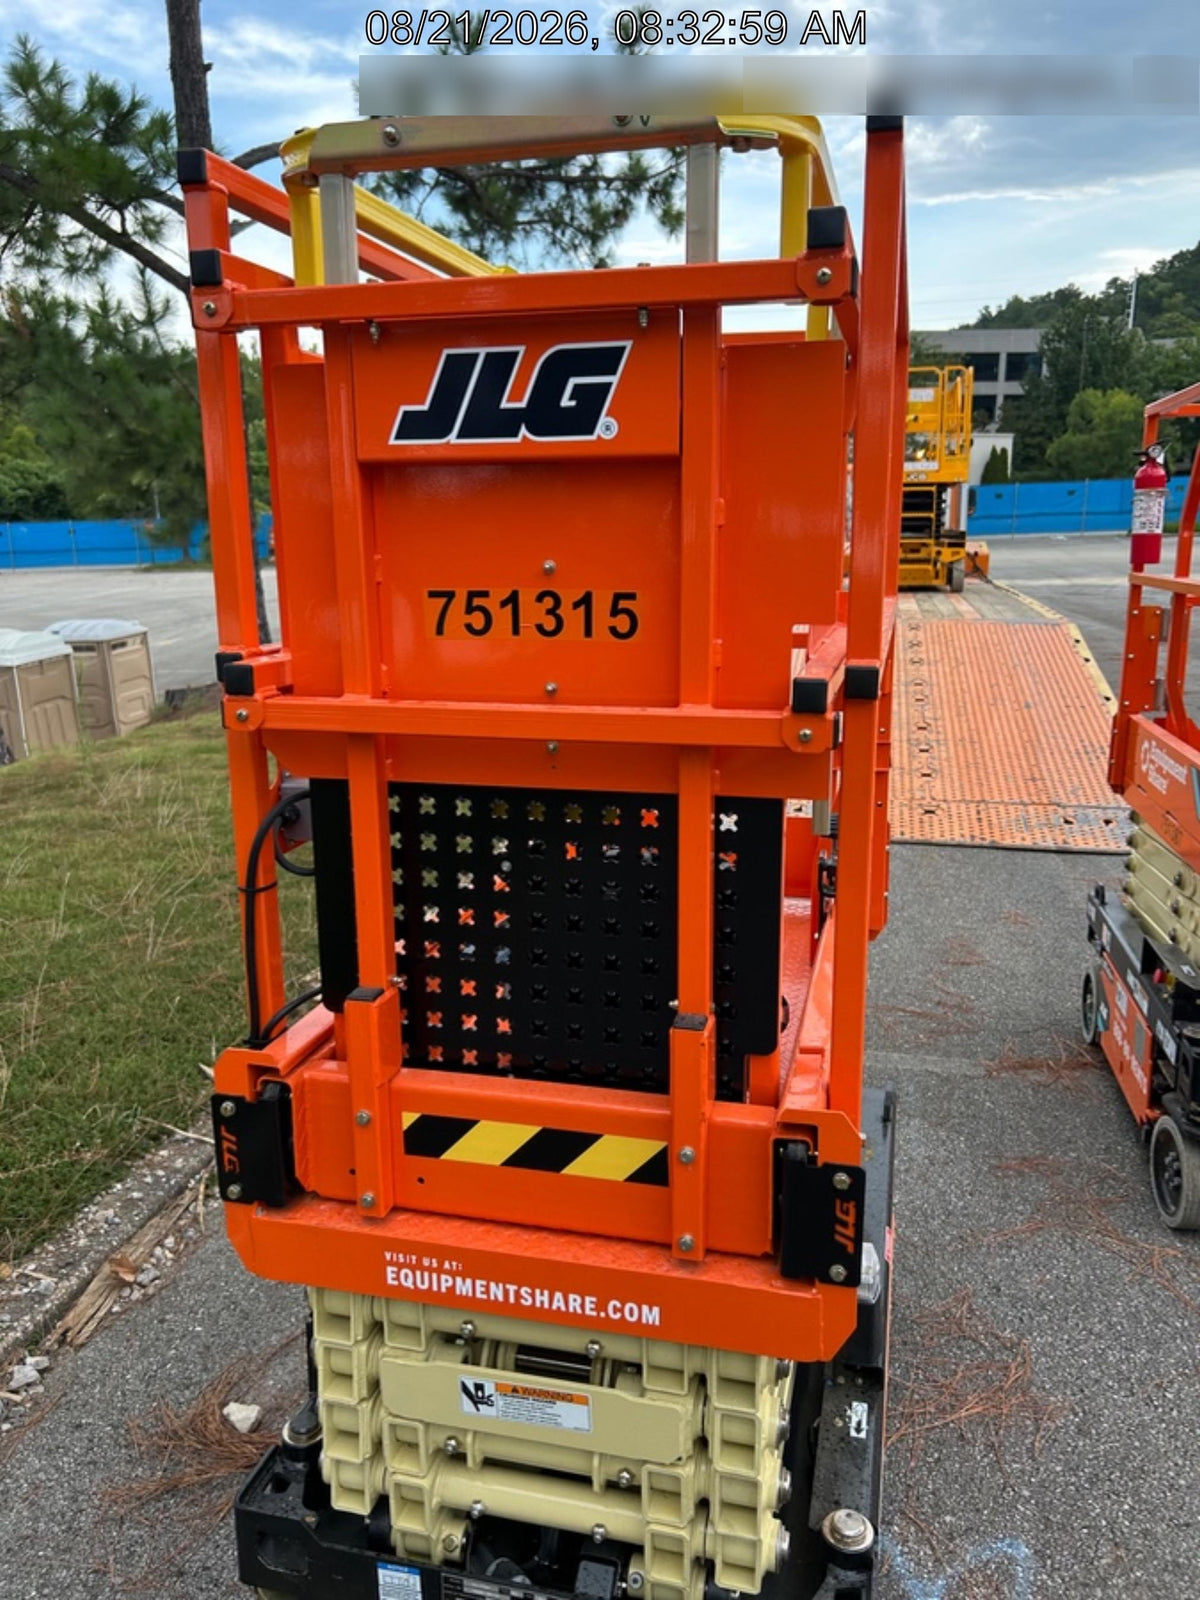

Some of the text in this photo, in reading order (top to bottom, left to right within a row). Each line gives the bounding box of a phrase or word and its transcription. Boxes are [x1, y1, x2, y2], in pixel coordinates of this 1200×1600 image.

[388, 340, 633, 445] JLG
[427, 589, 639, 640] 751315
[220, 1124, 240, 1174] JLG
[834, 1198, 857, 1255] JLG
[384, 1251, 463, 1271] VISIT US AT:
[385, 1266, 661, 1326] EQUIPMENTSHARE.COM
